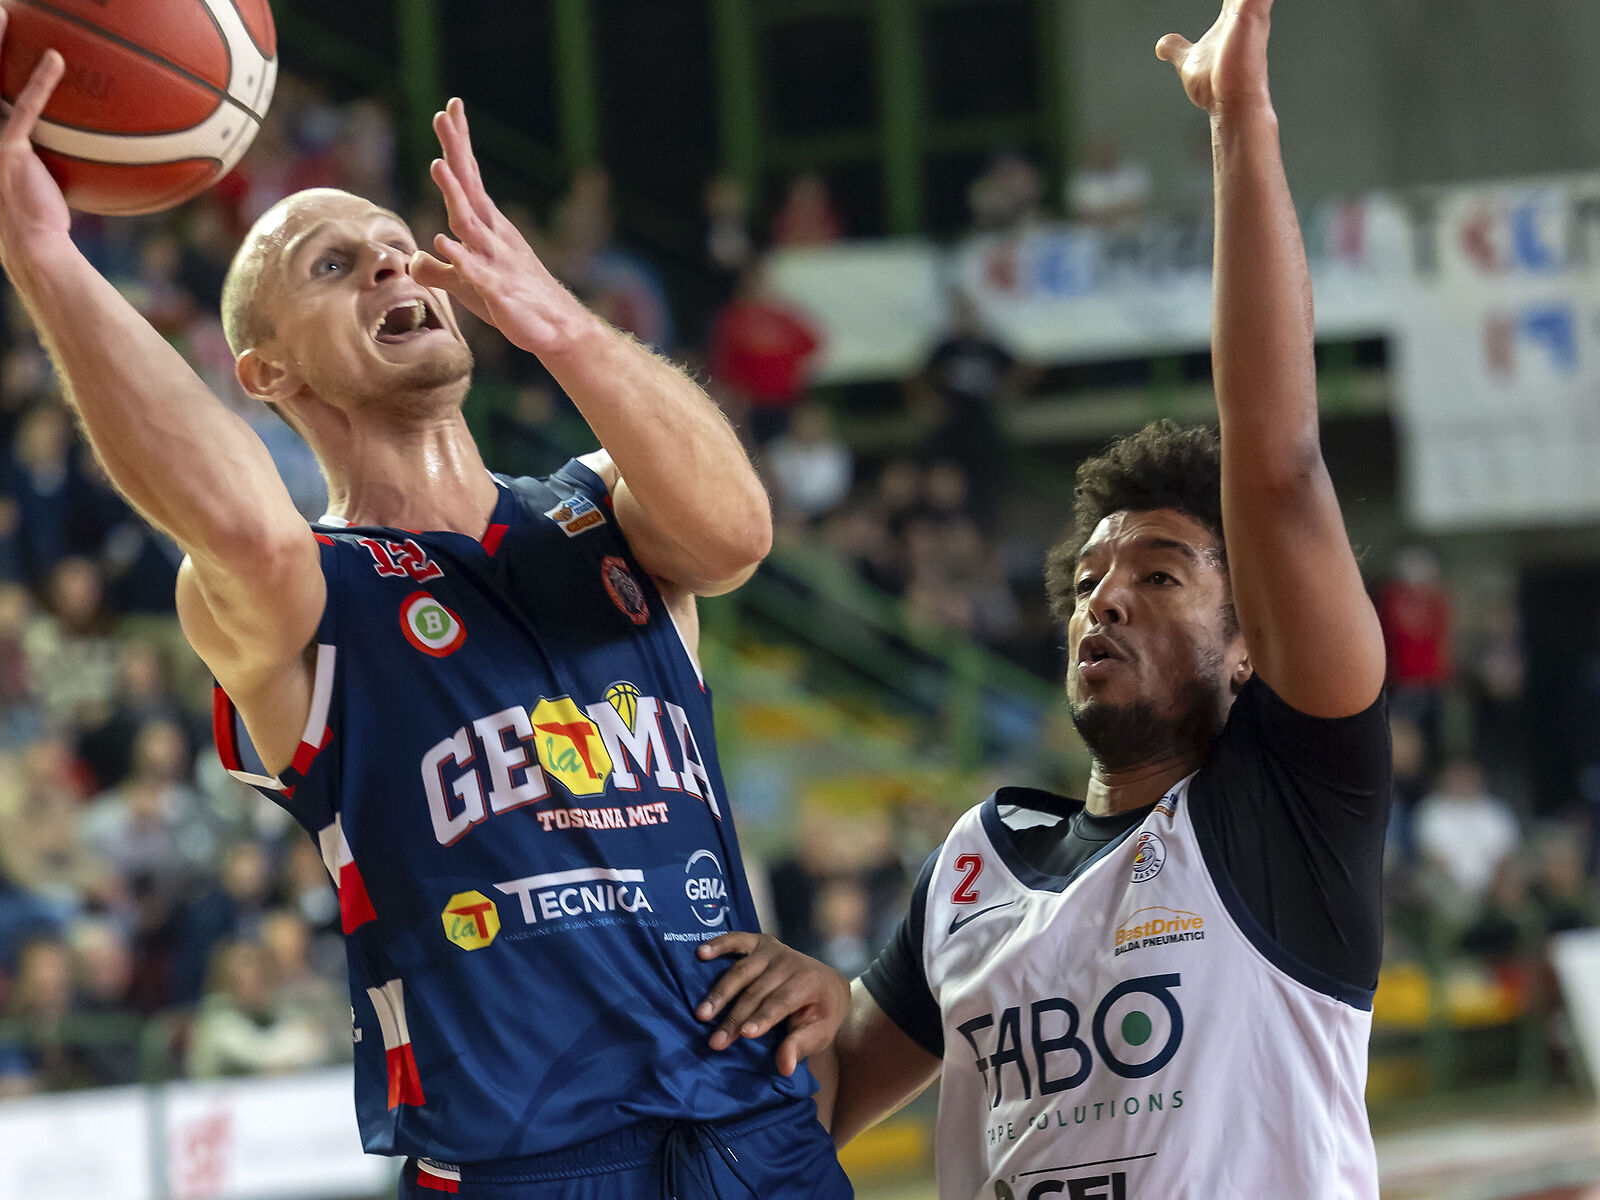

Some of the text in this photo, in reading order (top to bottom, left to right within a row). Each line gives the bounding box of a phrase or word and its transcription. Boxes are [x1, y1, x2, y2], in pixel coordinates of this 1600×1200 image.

[356, 538, 445, 584] 12
[422, 611, 443, 634] B
[537, 802, 669, 832] TOSCANA MCT
[492, 867, 653, 925] TECNICA
[951, 853, 985, 904] 2
[1114, 930, 1204, 957] BALDA PNEUMATICI
[1115, 916, 1204, 946] BestDrive
[956, 973, 1184, 1111] FABO
